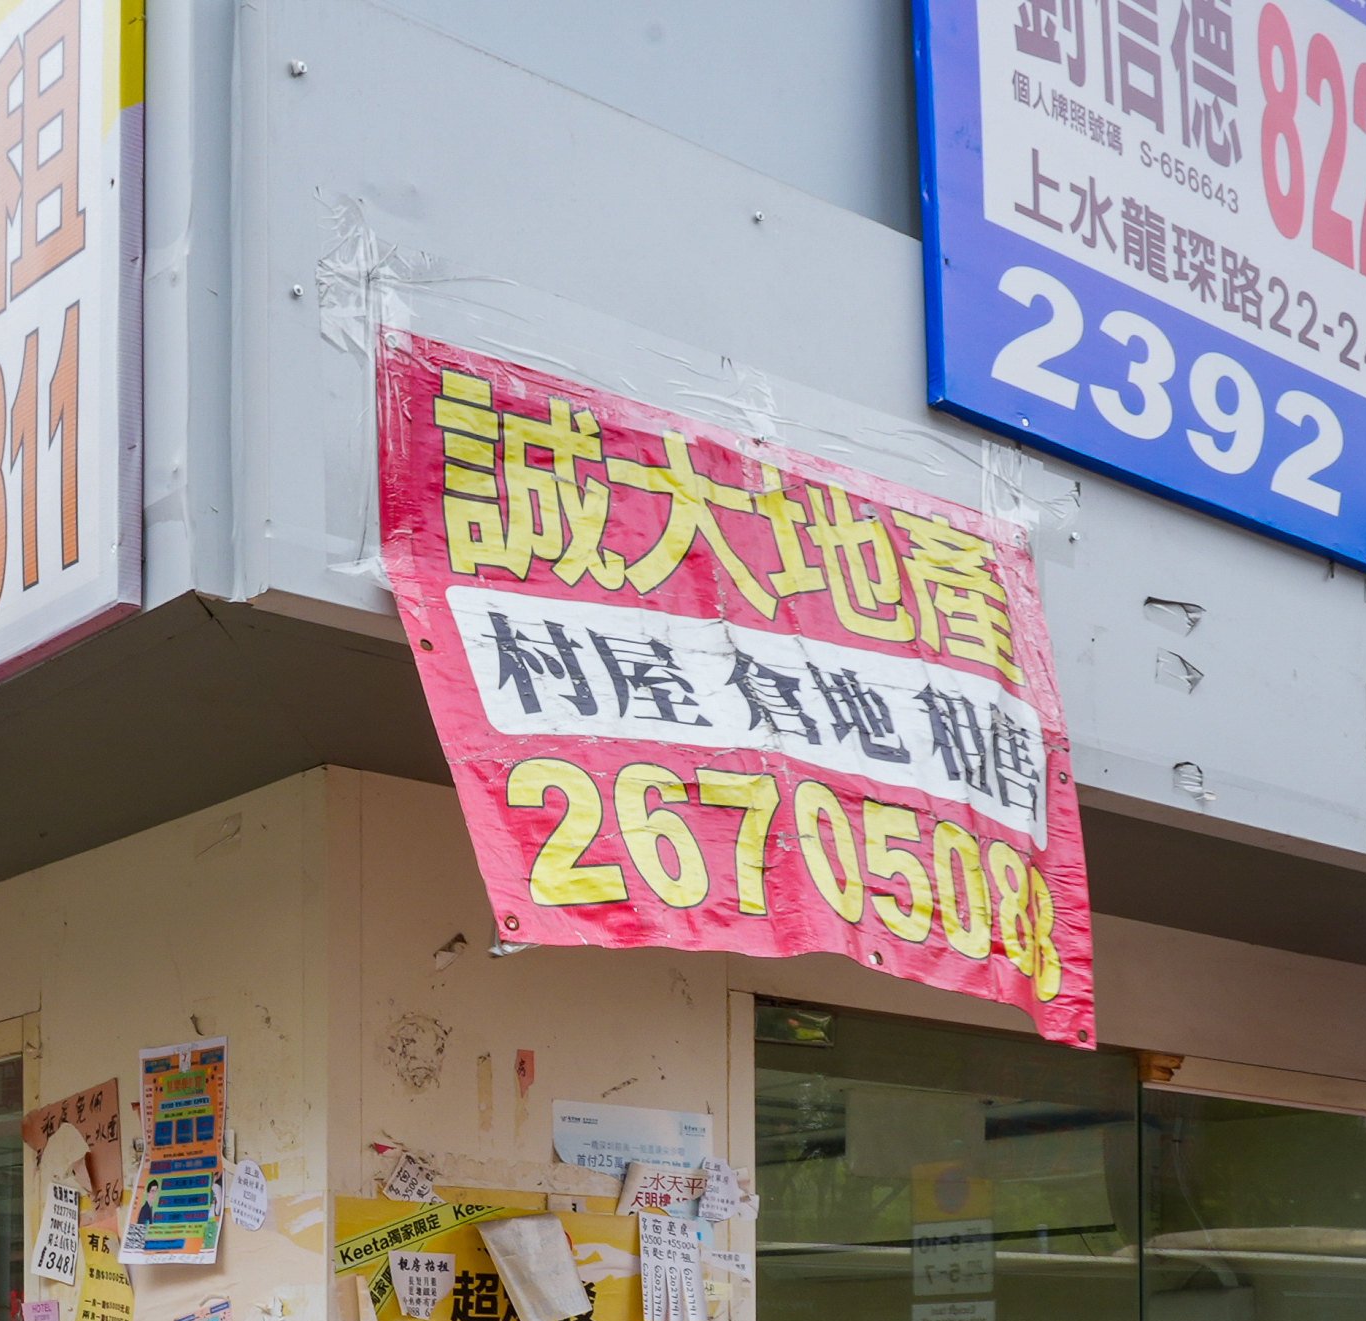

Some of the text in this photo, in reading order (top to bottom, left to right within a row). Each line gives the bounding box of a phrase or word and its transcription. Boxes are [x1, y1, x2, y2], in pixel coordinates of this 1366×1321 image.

[1011, 68, 1240, 214] 個人牌照號碼 S-656643
[990, 264, 1346, 517] 2392
[488, 611, 713, 727] 村屋
[726, 649, 911, 765] 倉地
[506, 757, 1063, 1004] 26705088
[31, 1304, 53, 1314] HOTEL
